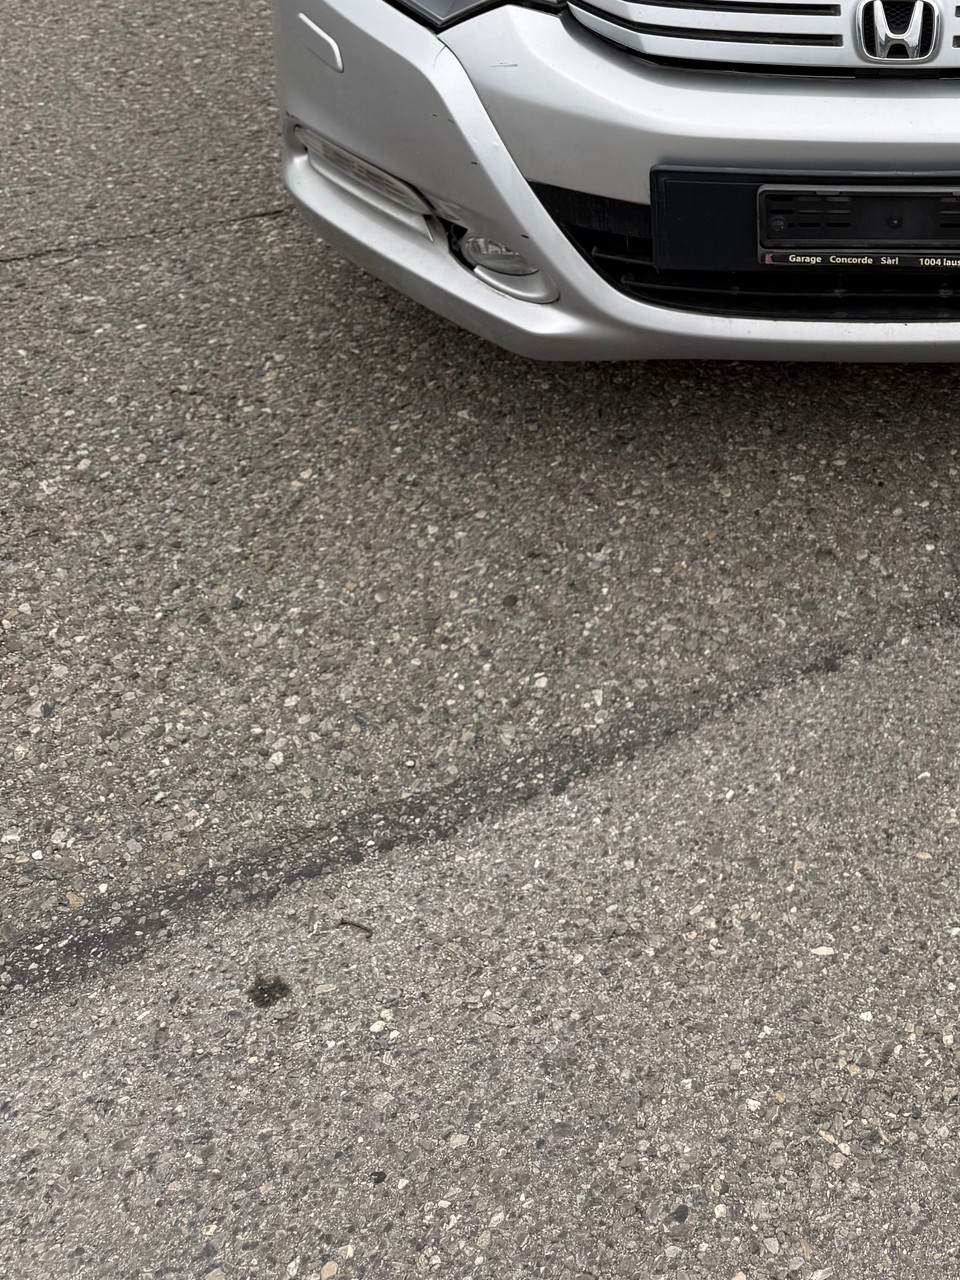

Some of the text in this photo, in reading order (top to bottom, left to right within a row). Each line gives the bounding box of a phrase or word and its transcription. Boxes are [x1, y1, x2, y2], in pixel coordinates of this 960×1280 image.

[788, 254, 822, 264] Garage
[829, 255, 873, 264] Concorde
[919, 258, 942, 266] 1004
